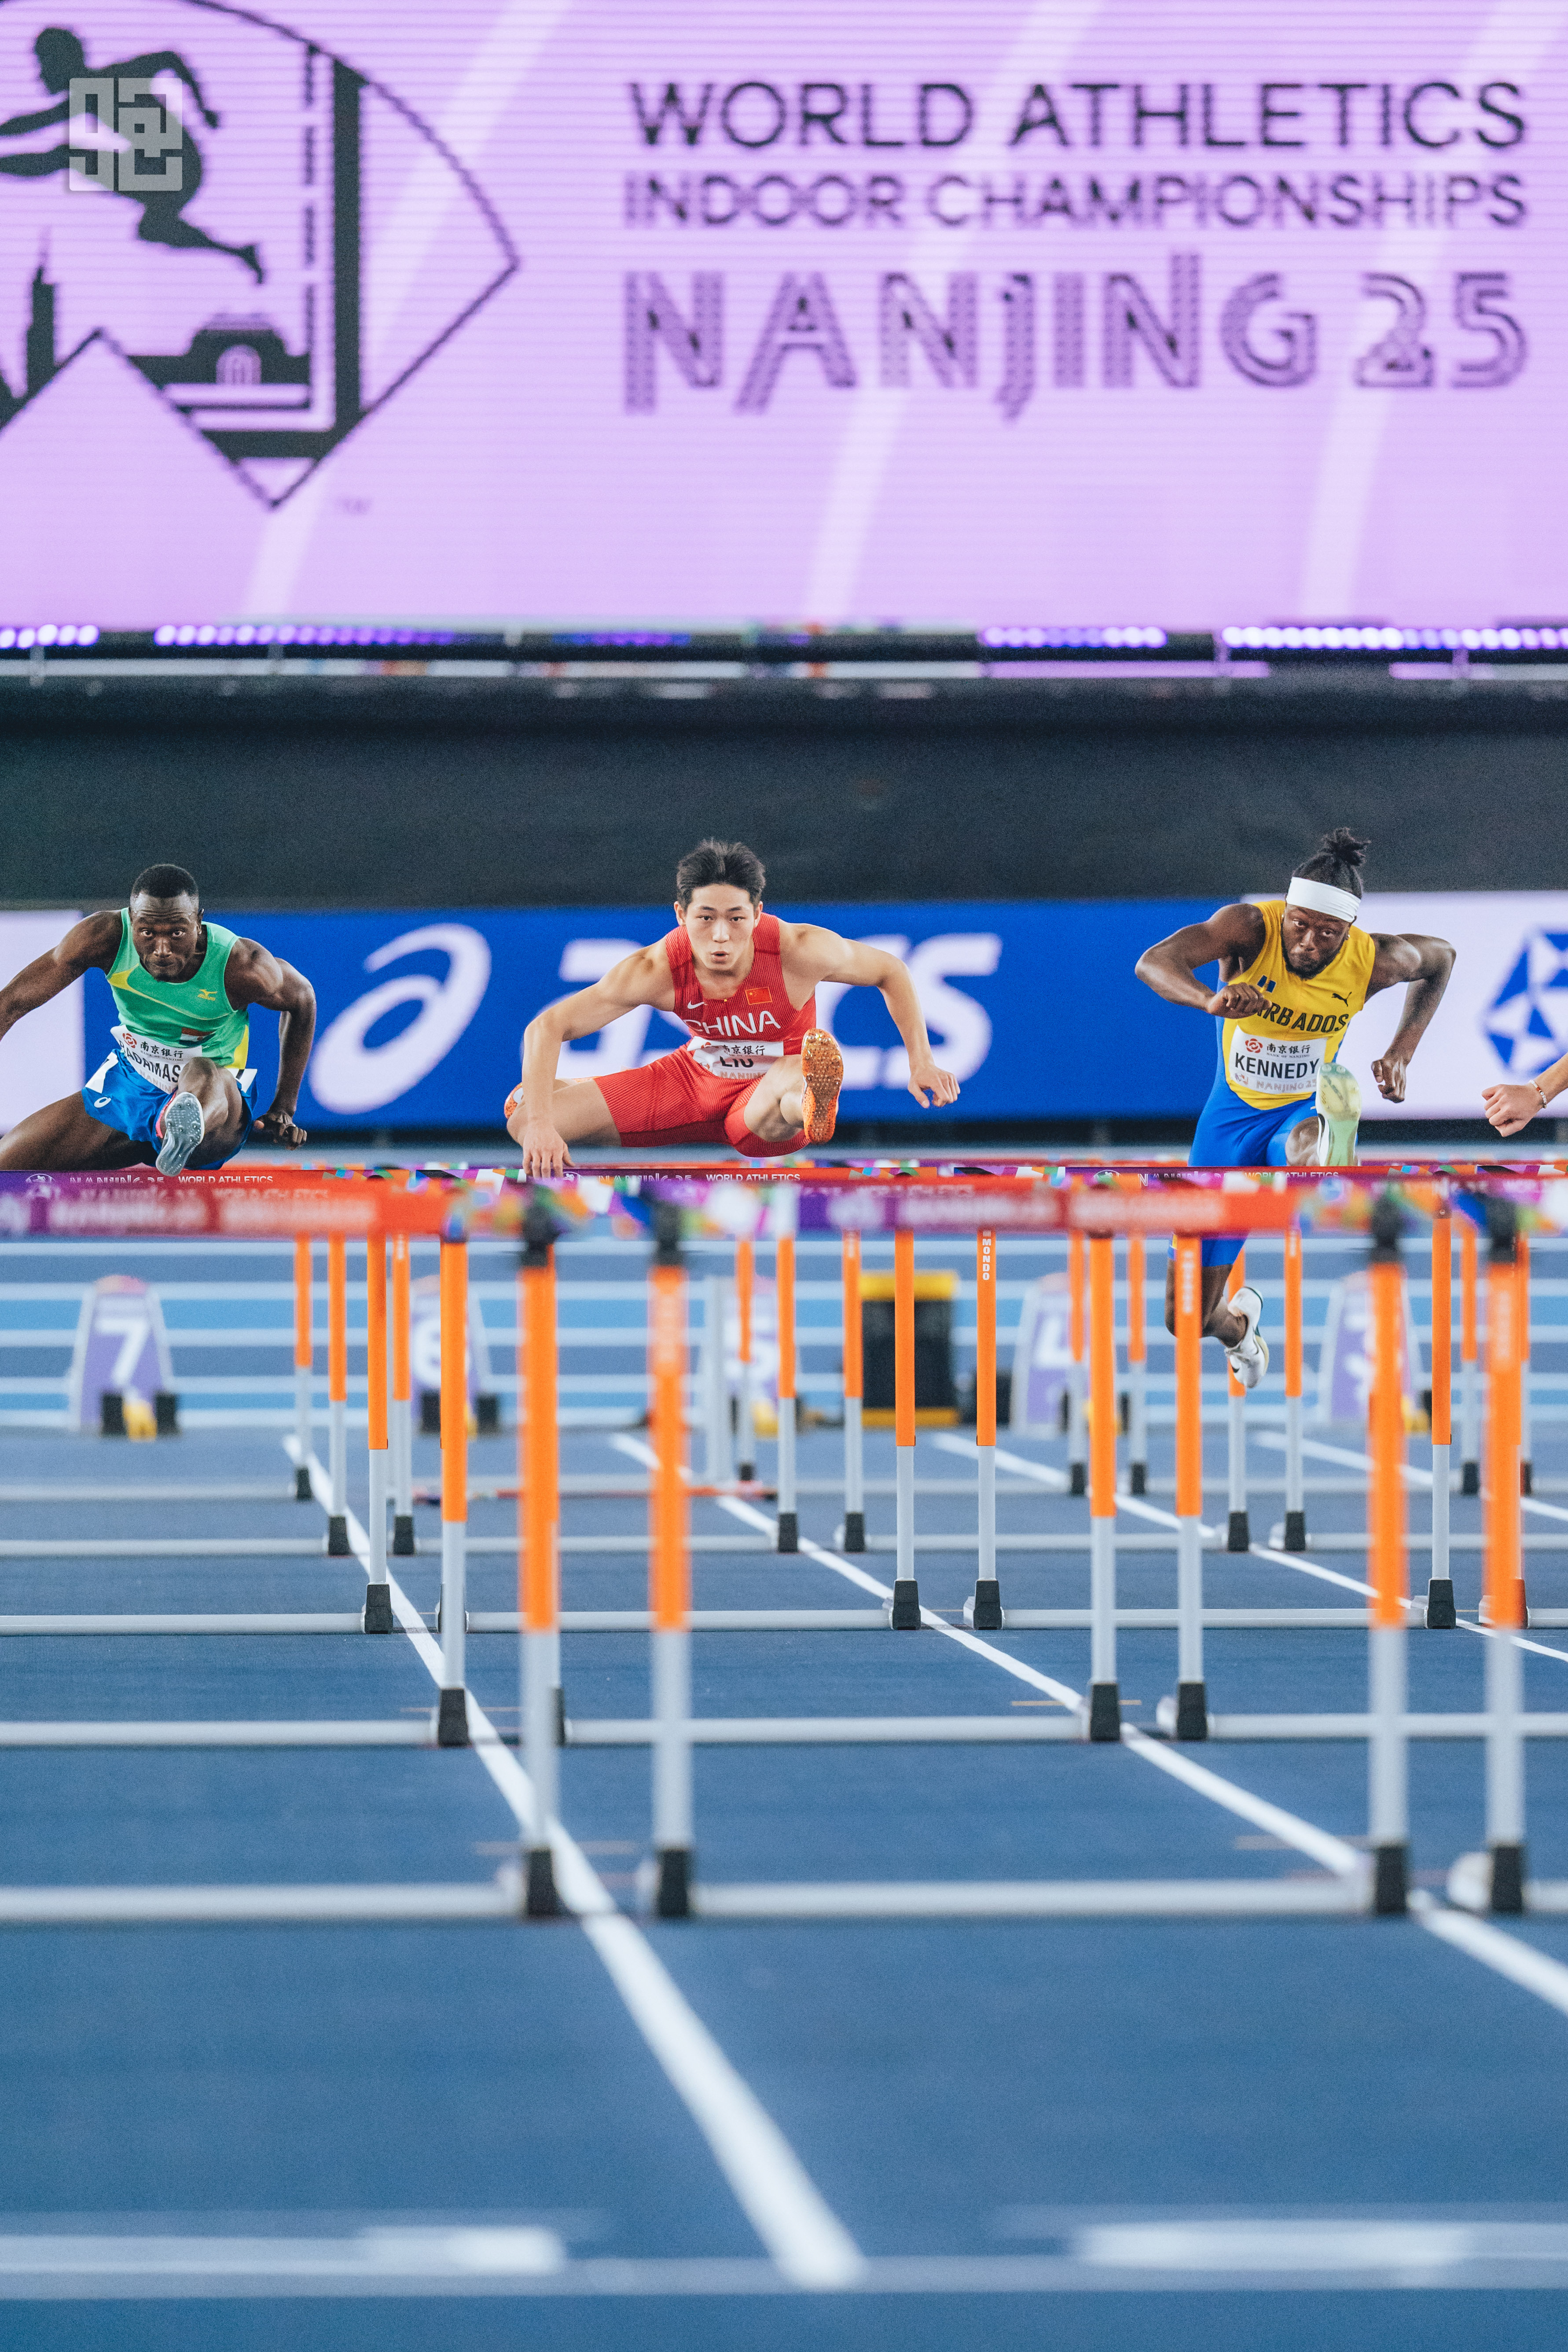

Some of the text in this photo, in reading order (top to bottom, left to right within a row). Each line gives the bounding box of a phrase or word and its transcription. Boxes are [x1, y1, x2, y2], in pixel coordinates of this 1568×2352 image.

[630, 82, 1526, 148] WORLD ATHLETICS
[625, 174, 1527, 226] INDOOR CHAMPIONSHIPS
[623, 252, 1528, 423] NANJING 25
[683, 1011, 781, 1036] CHINA
[1257, 1002, 1349, 1033] RBADOS
[140, 1041, 184, 1058] 南京银行
[720, 1056, 754, 1068] LIU
[1267, 1043, 1311, 1054] 南京银行
[1235, 1052, 1320, 1079] KENNEDY
[982, 1238, 991, 1280] MONDO
[96, 1318, 150, 1385] 7
